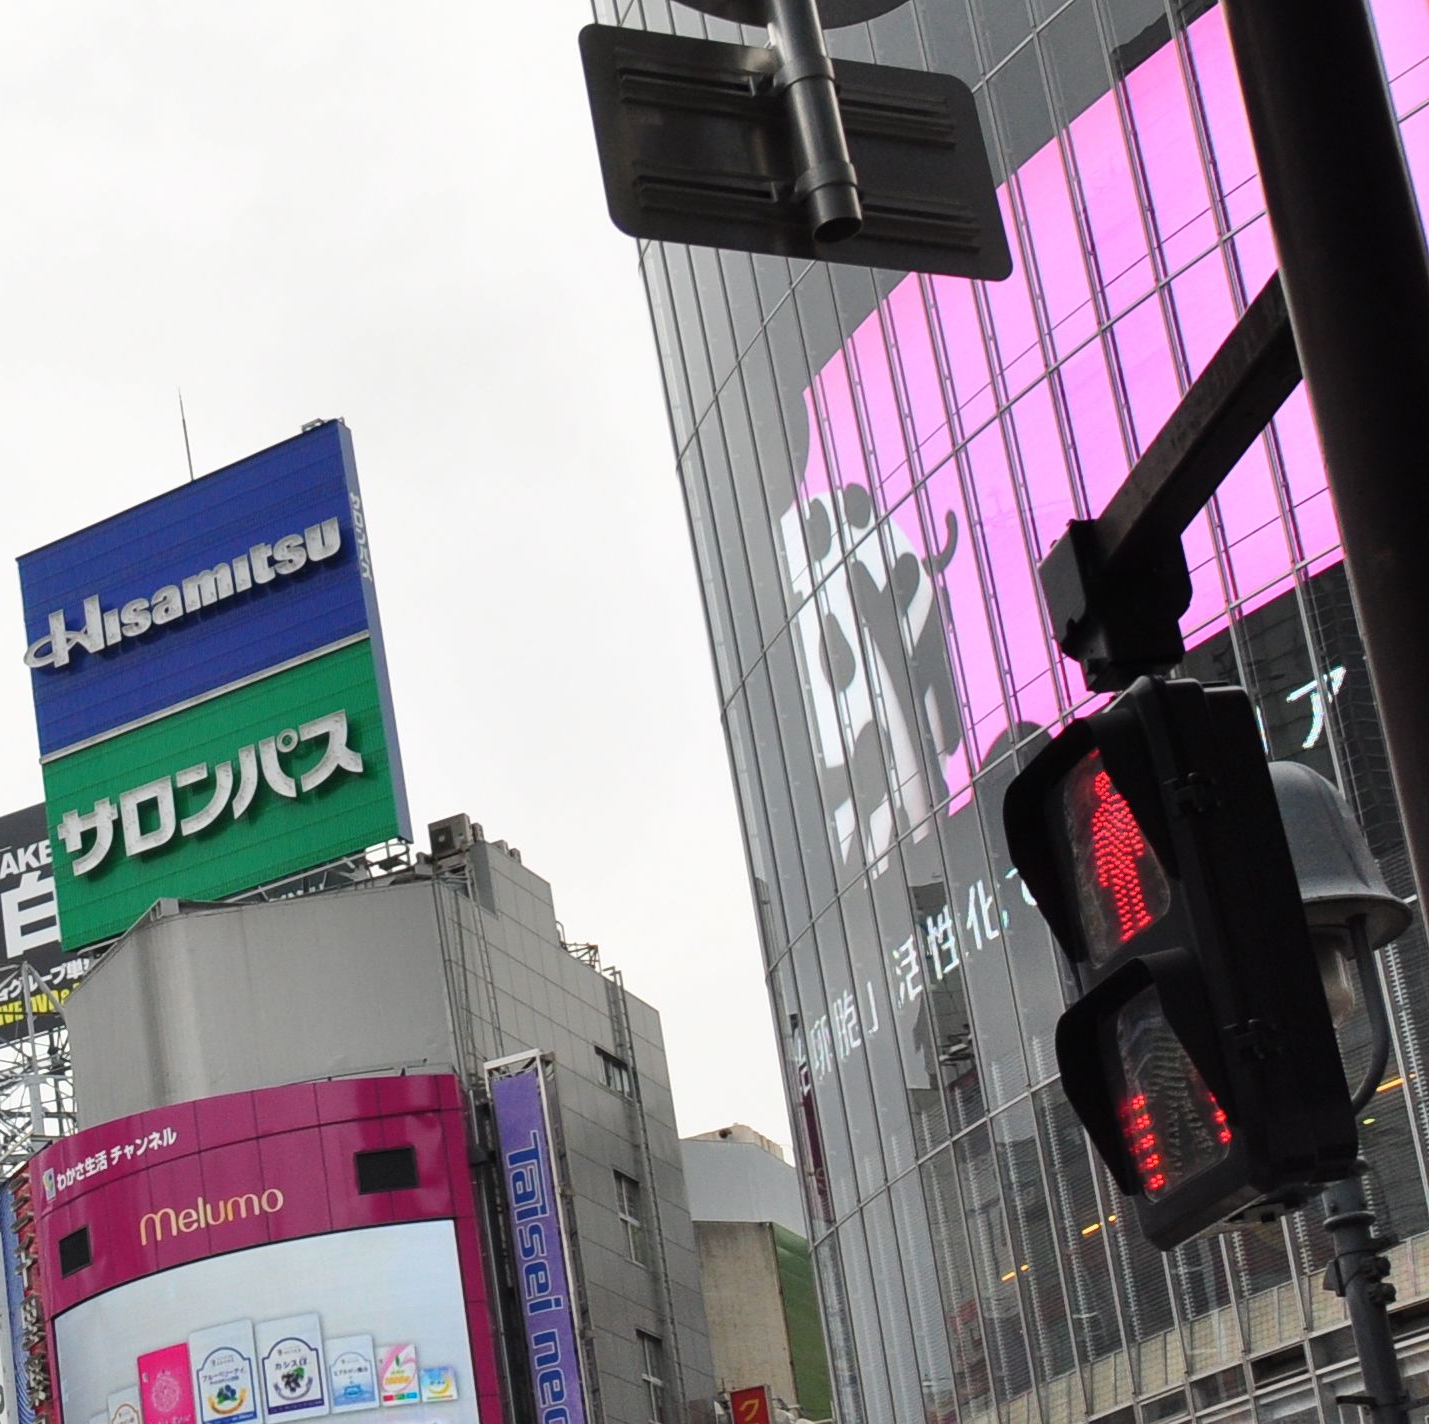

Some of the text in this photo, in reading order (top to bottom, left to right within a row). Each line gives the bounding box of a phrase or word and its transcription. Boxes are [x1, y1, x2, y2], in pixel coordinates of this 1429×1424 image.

[23, 516, 342, 669] Hisamitsu
[56, 708, 364, 877] サロンパス
[55, 1126, 178, 1192] わかさ生活 チャンネル
[502, 1130, 565, 1317] Taisei
